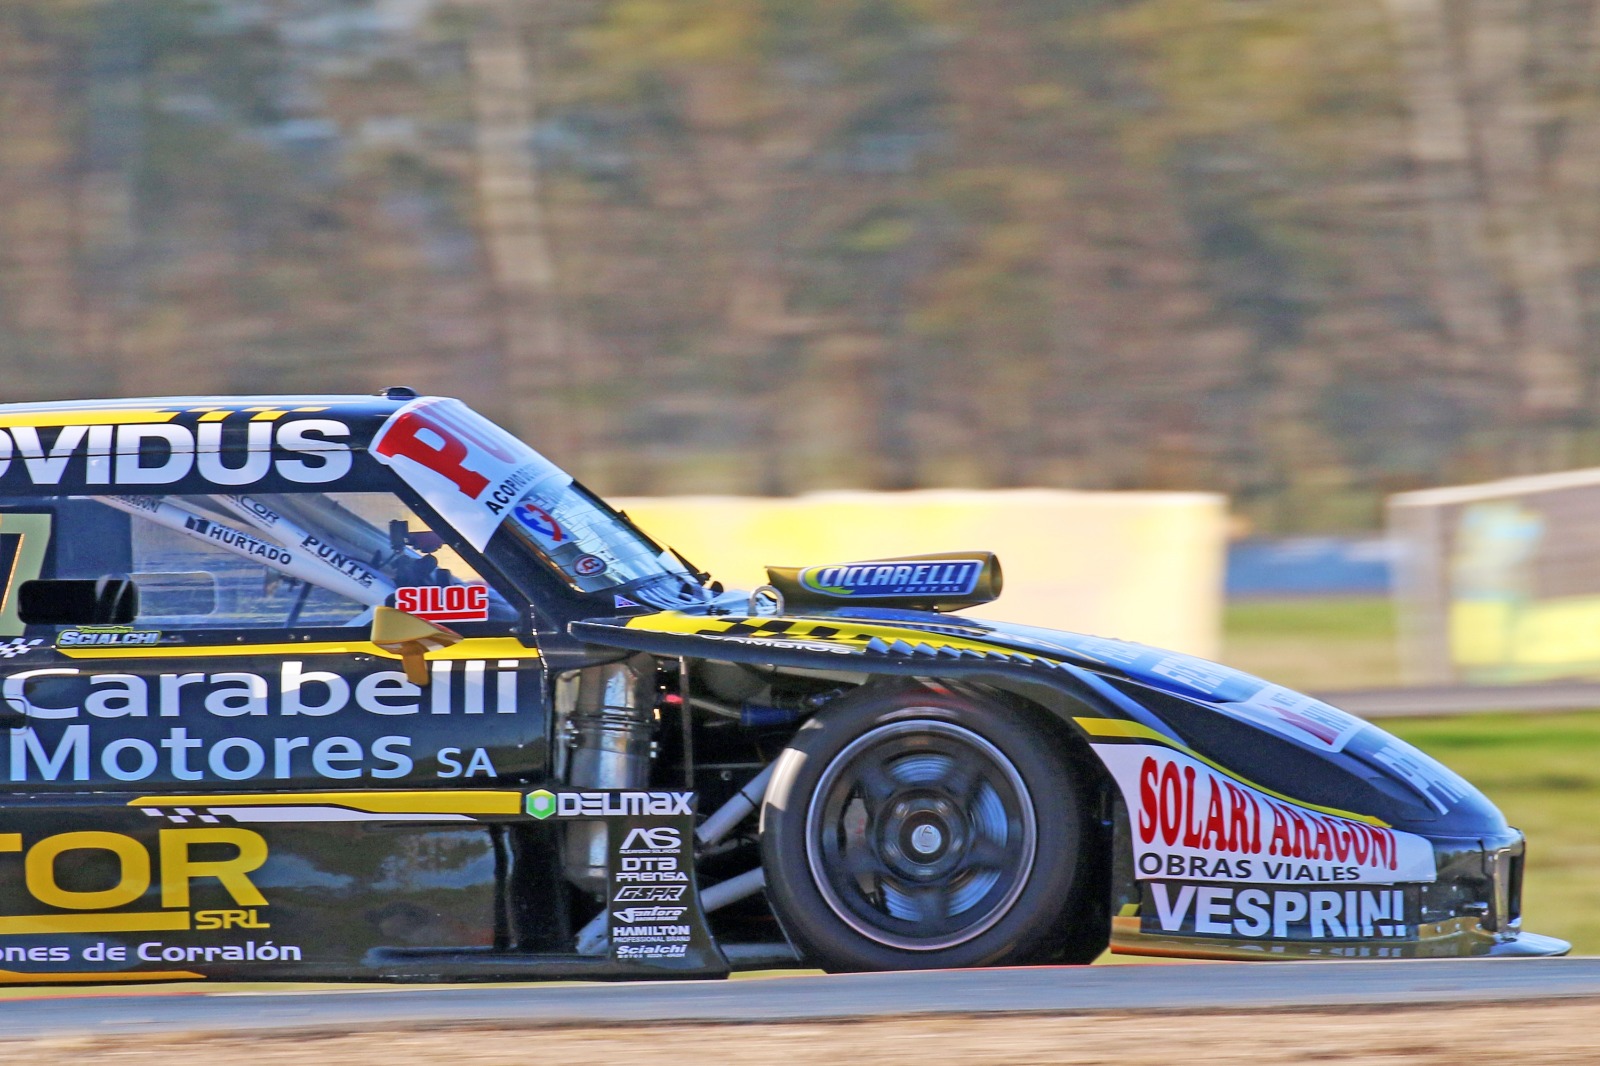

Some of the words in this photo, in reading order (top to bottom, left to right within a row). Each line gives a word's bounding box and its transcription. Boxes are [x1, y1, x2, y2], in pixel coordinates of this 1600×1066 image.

[0, 419, 353, 485] VIDUS
[210, 526, 292, 565] HURTADO
[302, 535, 379, 586] PUNTE
[820, 564, 971, 587] CICCARELLI
[398, 586, 487, 612] SILOC
[3, 660, 519, 719] Carabelli
[9, 724, 414, 782] Motores
[436, 747, 498, 779] SA
[1138, 756, 1262, 854] SOLARI
[0, 827, 270, 909] OR
[195, 910, 271, 930] SRL
[616, 872, 689, 882] PRENSA
[622, 857, 677, 871] DTB
[1138, 852, 1252, 879] OBRAS
[1263, 861, 1361, 881] VIALES
[613, 925, 690, 936] HAMILTON
[0, 945, 69, 962] nes
[137, 941, 302, 962] Corralón
[616, 944, 688, 954] Scialchi
